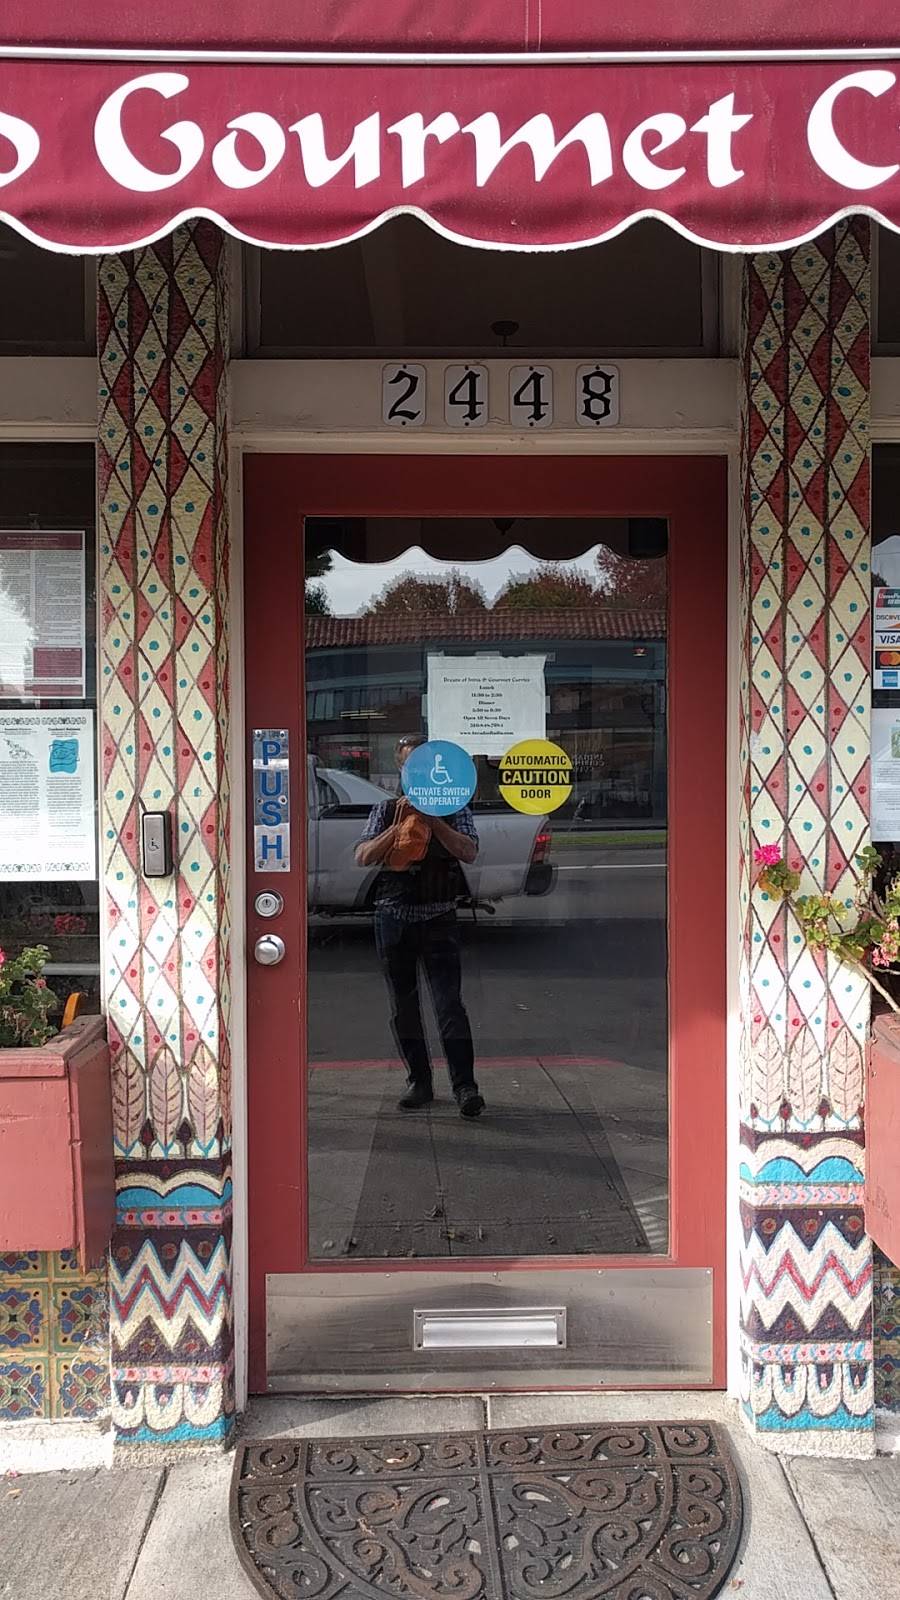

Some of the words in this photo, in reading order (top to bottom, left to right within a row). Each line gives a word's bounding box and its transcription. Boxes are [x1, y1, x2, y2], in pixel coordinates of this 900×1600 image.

[94, 72, 754, 193] Gourmet
[388, 370, 615, 421] 2448
[505, 755, 567, 766] AUTOMATIC
[502, 770, 570, 784] CAUTION
[408, 787, 441, 796] ACTIVATE
[442, 787, 470, 796] SWITCH
[520, 789, 551, 799] DOOR
[260, 741, 283, 861] PUSH
[418, 796, 428, 806] TO
[429, 796, 460, 806] OPERATE
